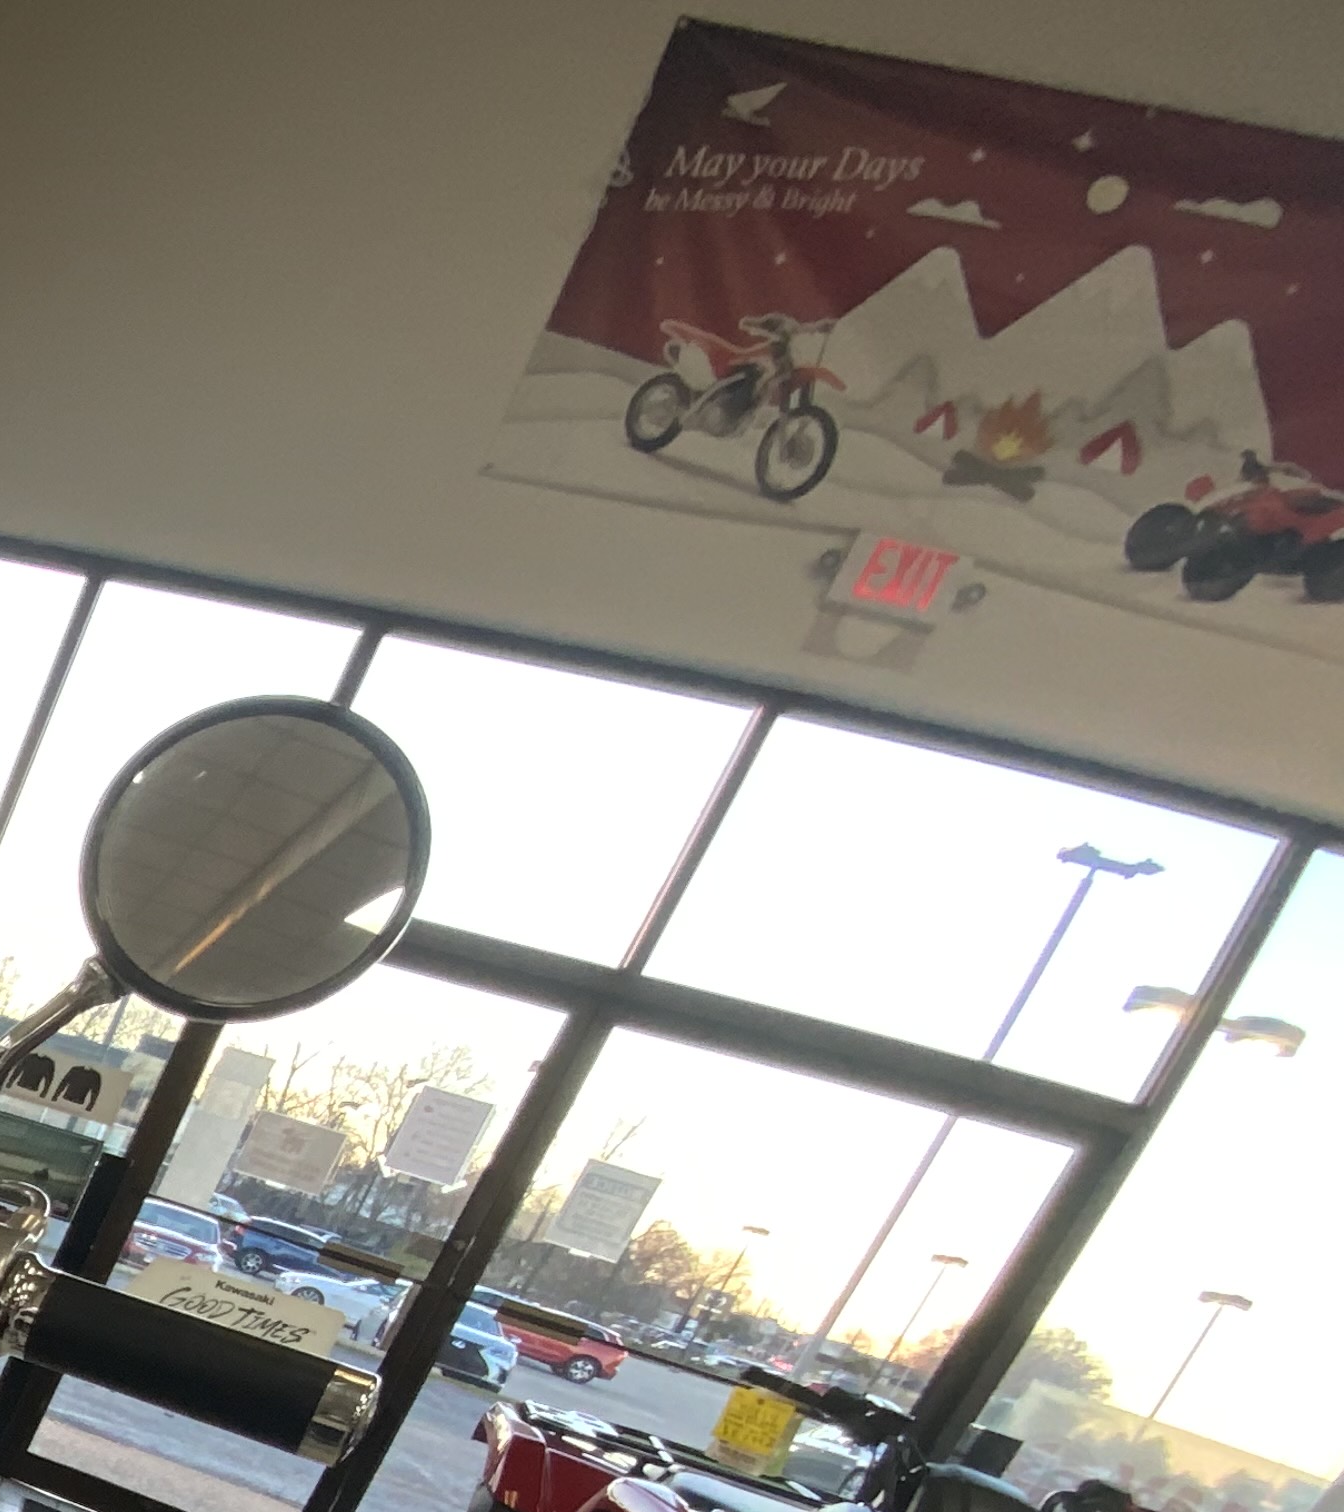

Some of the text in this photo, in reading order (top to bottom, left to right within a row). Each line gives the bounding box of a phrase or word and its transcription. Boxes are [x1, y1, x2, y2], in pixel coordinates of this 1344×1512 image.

[665, 145, 926, 191] May your Days
[781, 188, 858, 219] Bright
[851, 536, 960, 614] EXIT
[159, 1286, 311, 1344] GOOD TIMES
[214, 1279, 276, 1307] Kawasaki
